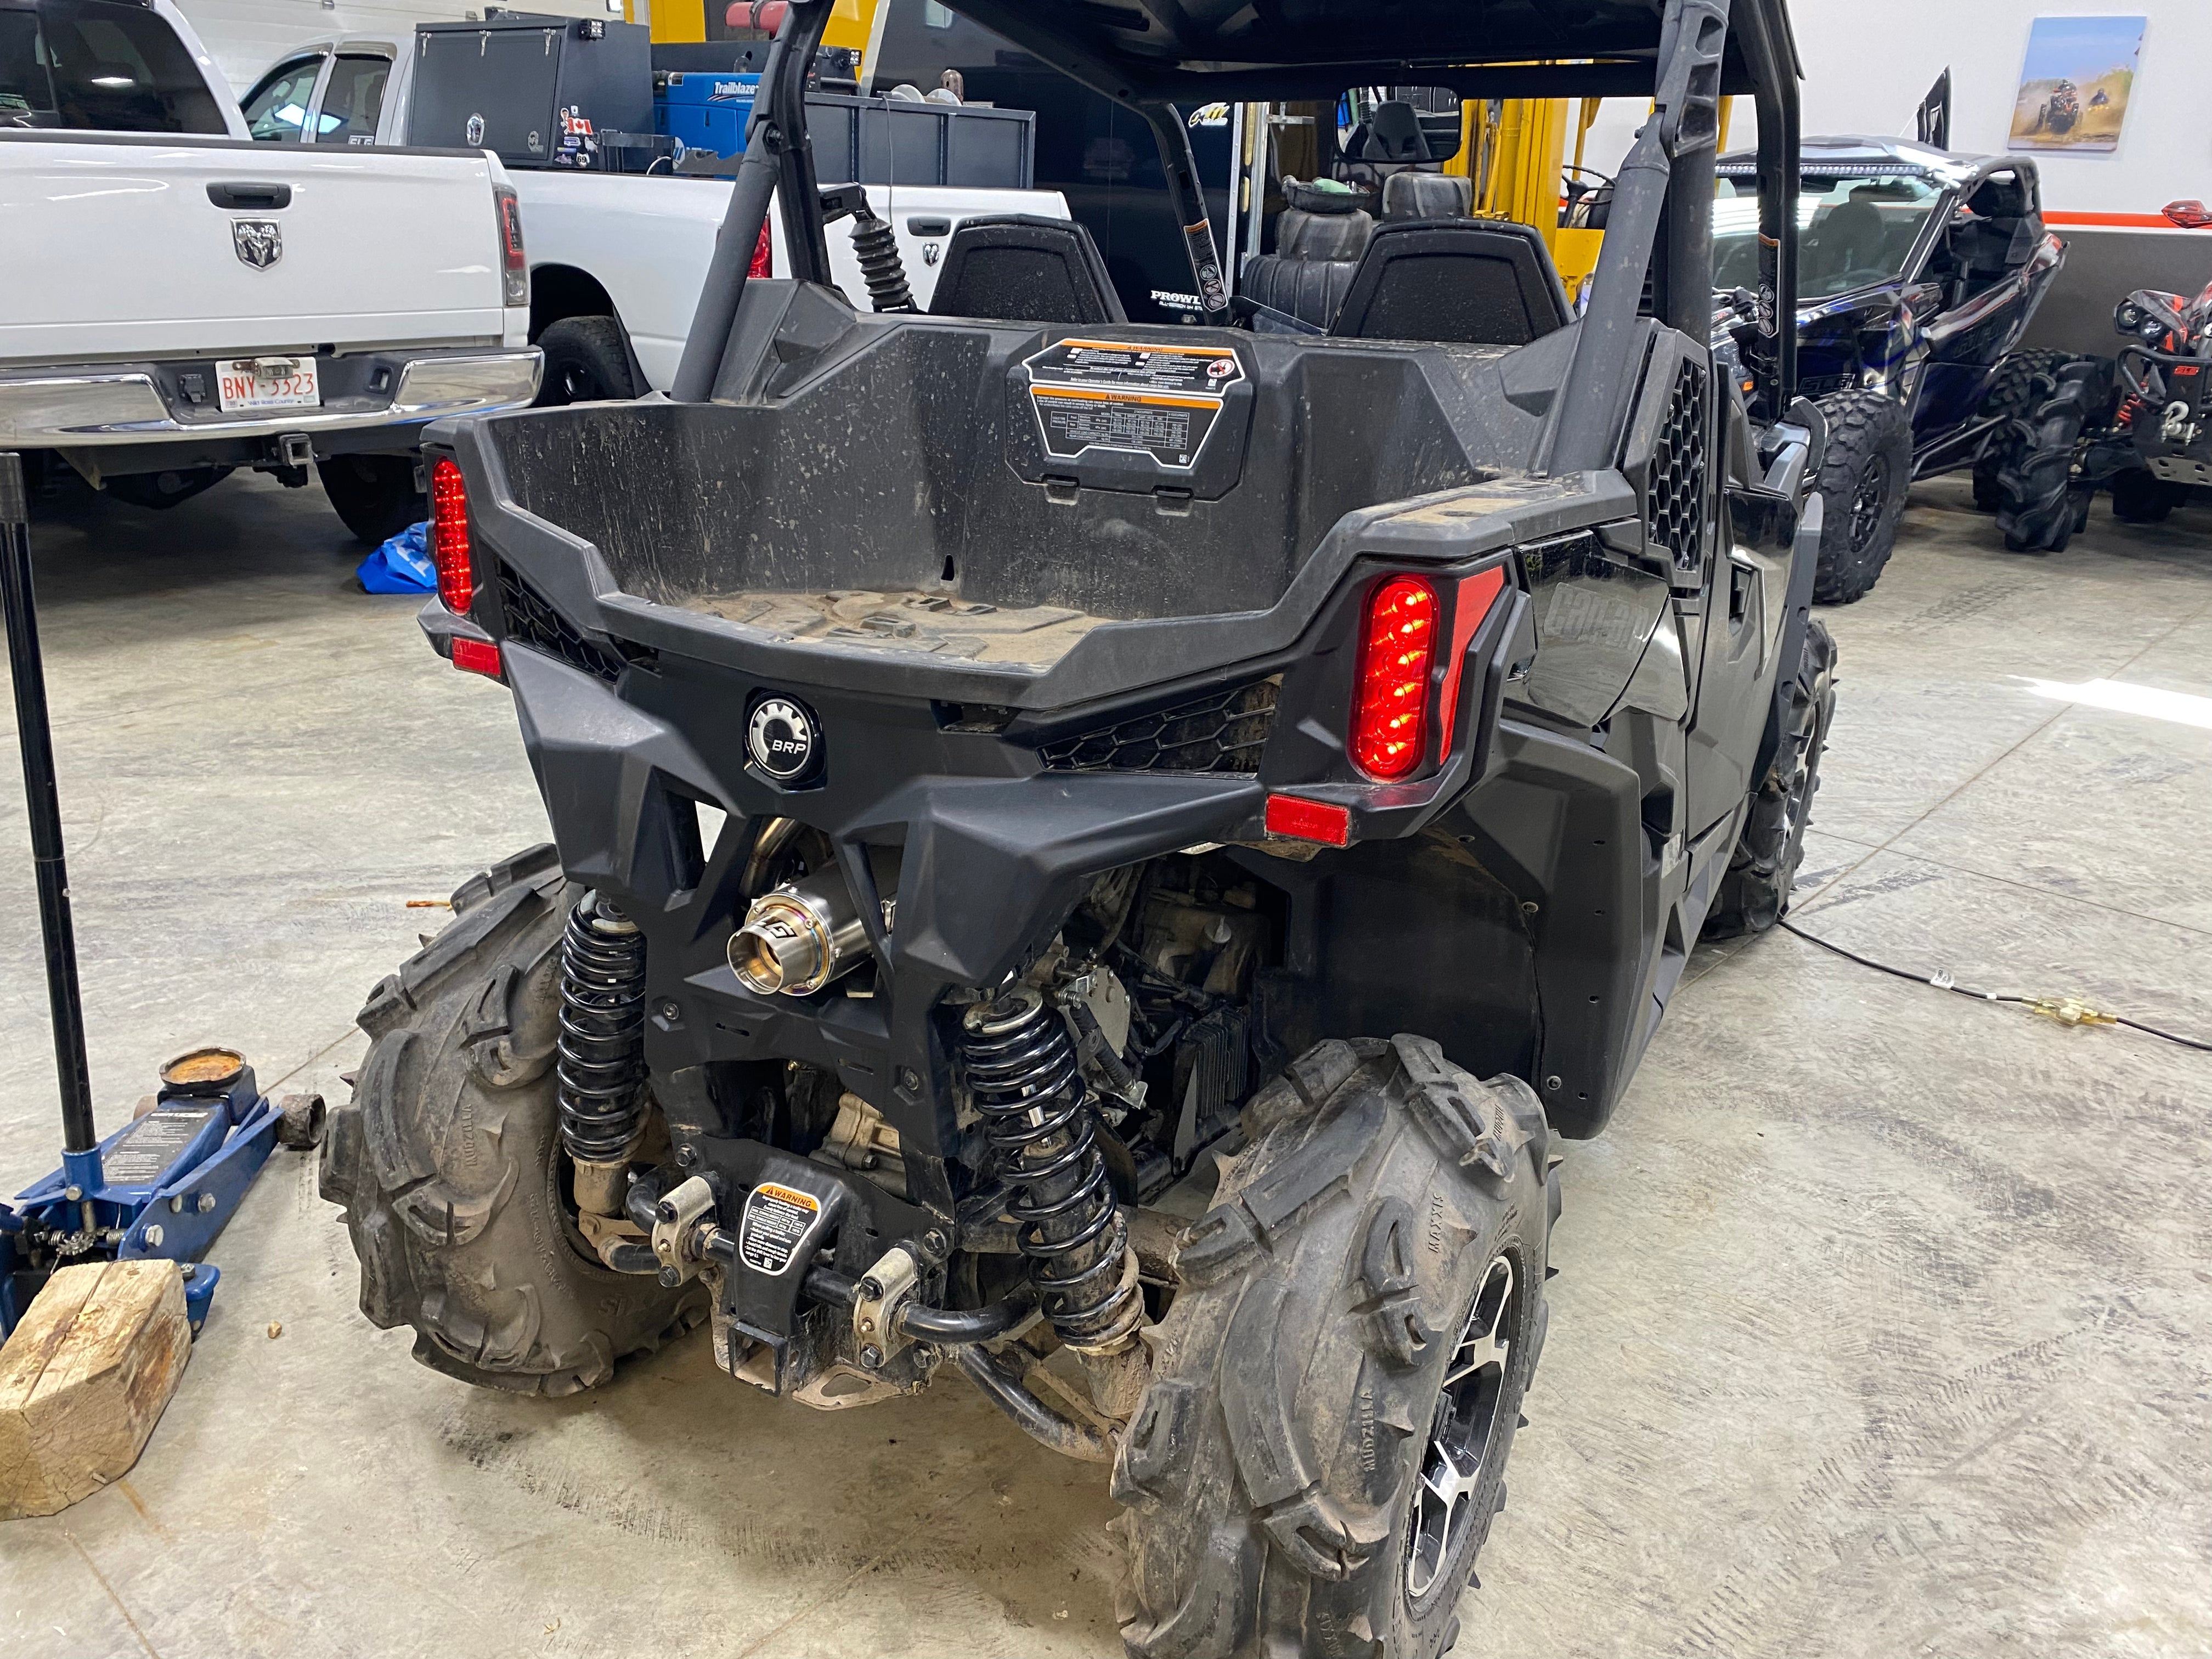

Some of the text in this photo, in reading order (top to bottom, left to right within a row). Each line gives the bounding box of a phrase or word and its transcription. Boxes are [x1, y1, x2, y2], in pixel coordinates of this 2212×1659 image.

[1111, 394, 1141, 402] WARNING
[772, 739, 807, 754] BRP
[461, 1103, 478, 1167] MUDZILLA
[775, 1189, 812, 1207] WARNING
[1428, 1192, 1443, 1254] MAXXIS
[1360, 1390, 1375, 1472] MUDZILLA
